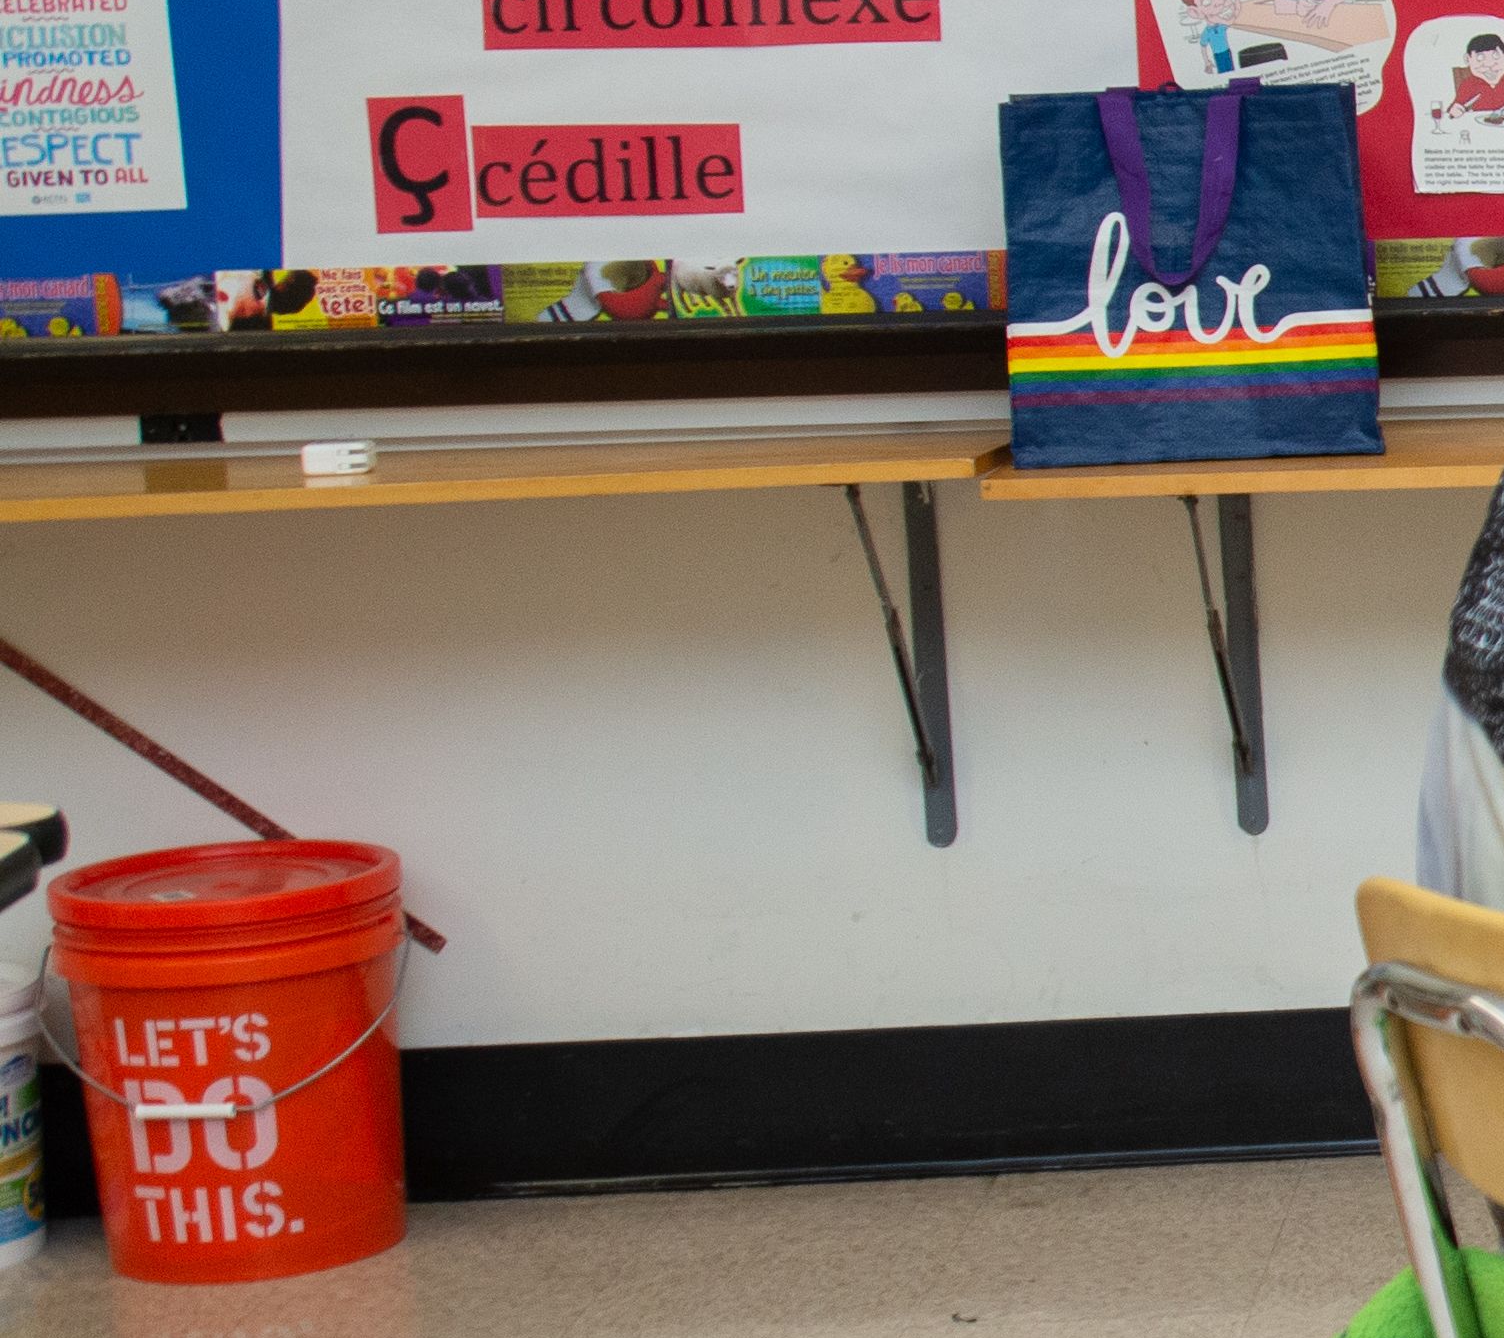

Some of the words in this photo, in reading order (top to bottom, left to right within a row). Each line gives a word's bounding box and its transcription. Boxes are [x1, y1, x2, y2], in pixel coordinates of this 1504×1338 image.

[7, 169, 73, 187] GIVEN
[80, 170, 108, 185] TO
[115, 168, 148, 184] ALL
[476, 131, 738, 205] cédille
[1086, 211, 1286, 358] love
[114, 1013, 271, 1068] LET'S
[123, 1075, 279, 1175] DO
[134, 1180, 305, 1244] THIS.
